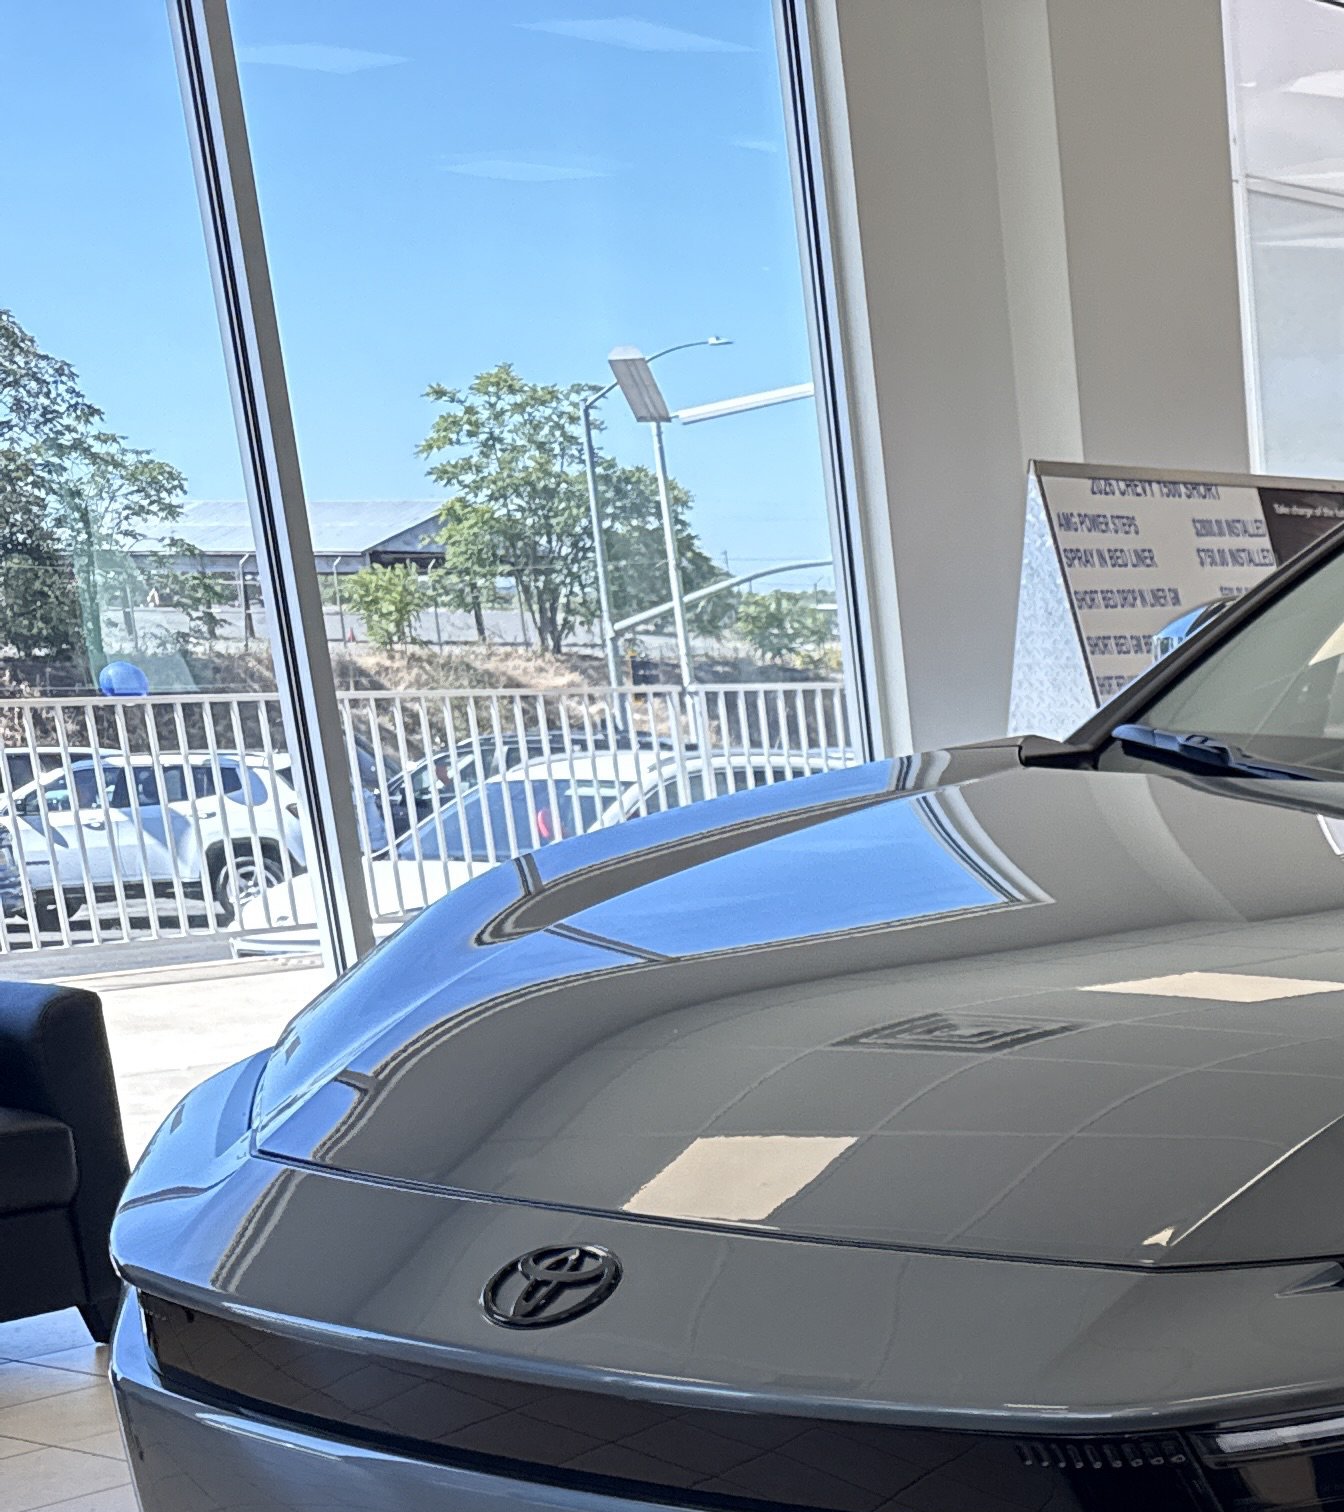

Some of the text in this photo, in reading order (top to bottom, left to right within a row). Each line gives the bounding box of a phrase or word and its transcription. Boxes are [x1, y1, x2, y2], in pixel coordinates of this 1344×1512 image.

[1116, 480, 1154, 497] CHEVY
[1183, 483, 1220, 500] SHORT
[1077, 512, 1110, 534] POWER
[1110, 515, 1139, 535] STEPS
[1225, 518, 1267, 537] INSTALLED
[1063, 548, 1158, 568] SPRAY IN BED LINER
[1228, 548, 1275, 567] INSTALLED
[1074, 589, 1101, 610] SHORT
[1100, 588, 1118, 609] BED
